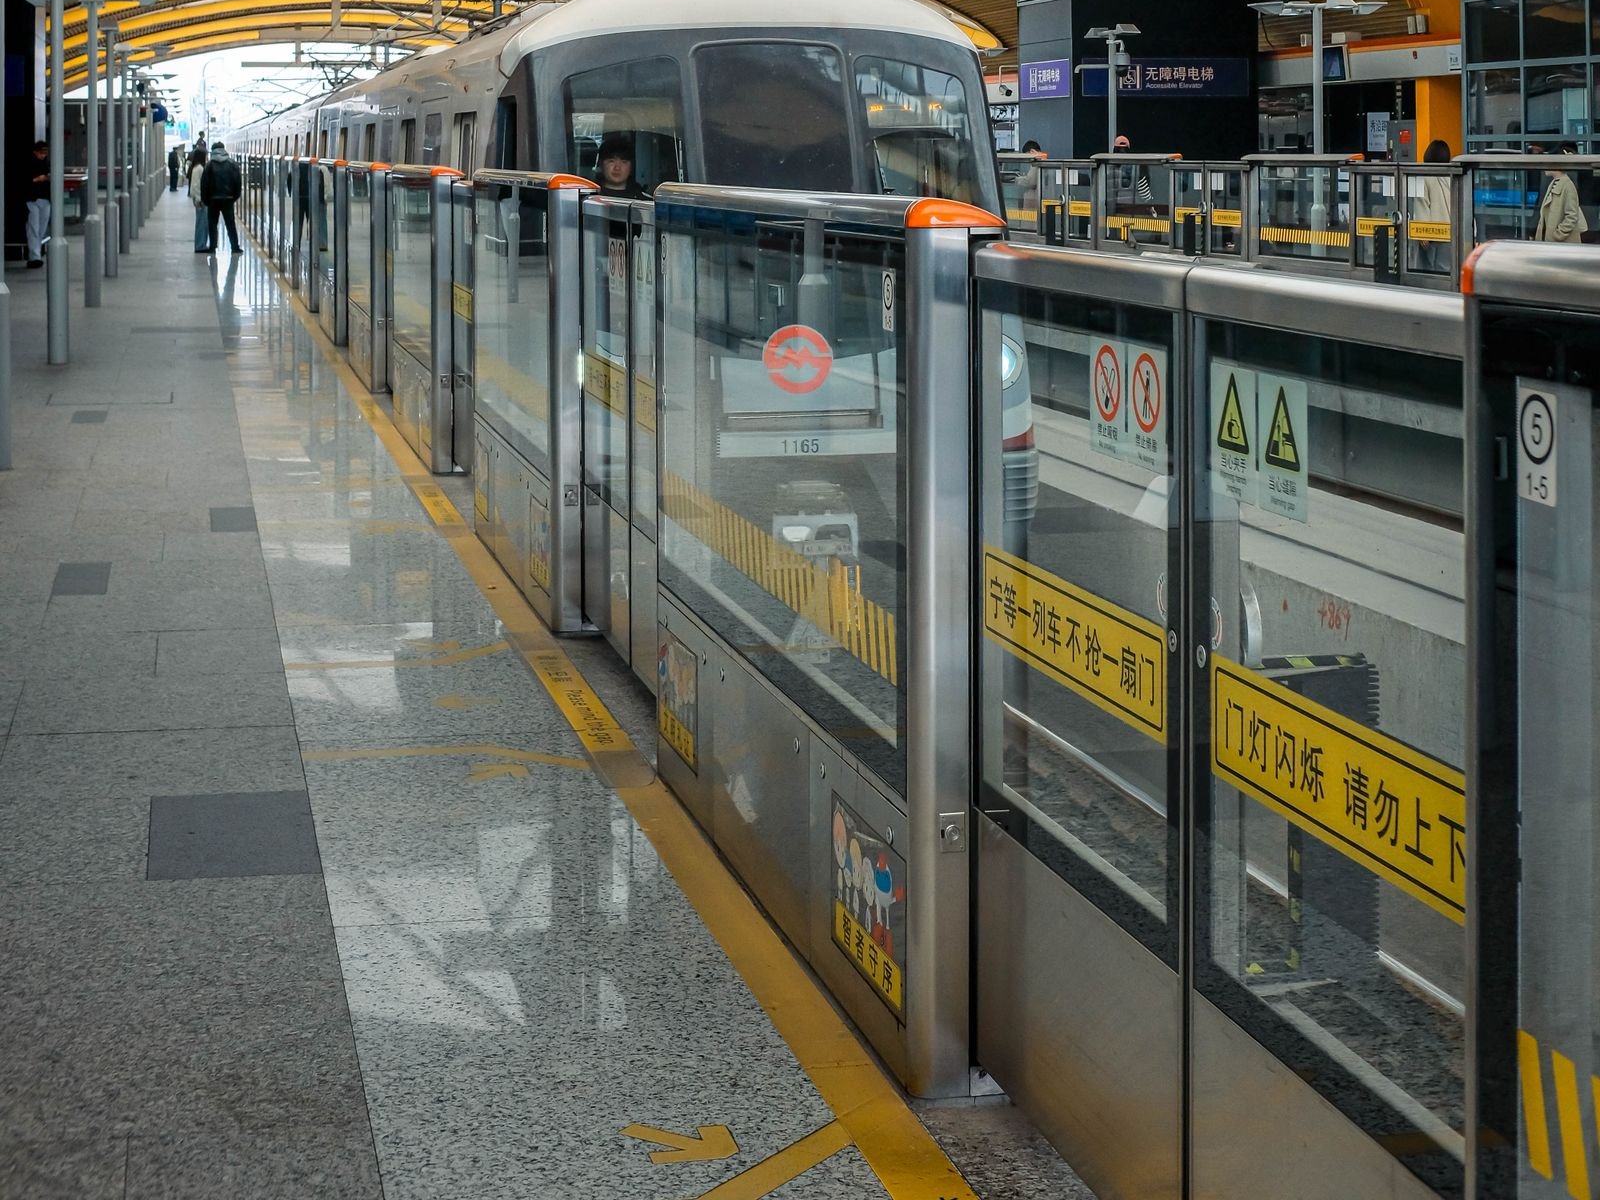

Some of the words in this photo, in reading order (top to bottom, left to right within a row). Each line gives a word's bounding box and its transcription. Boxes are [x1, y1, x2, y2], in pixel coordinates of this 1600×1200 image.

[1145, 67, 1214, 81] 无障碍电梯
[1531, 413, 1542, 445] 5
[781, 439, 820, 454] 1165
[1526, 472, 1548, 500] 1-5
[990, 576, 1155, 707] 宁等一列车不抢一扇门
[1225, 698, 1325, 803] 门灯闪烁
[1343, 762, 1466, 884] 请勿上下
[843, 912, 893, 994] 智者守序
